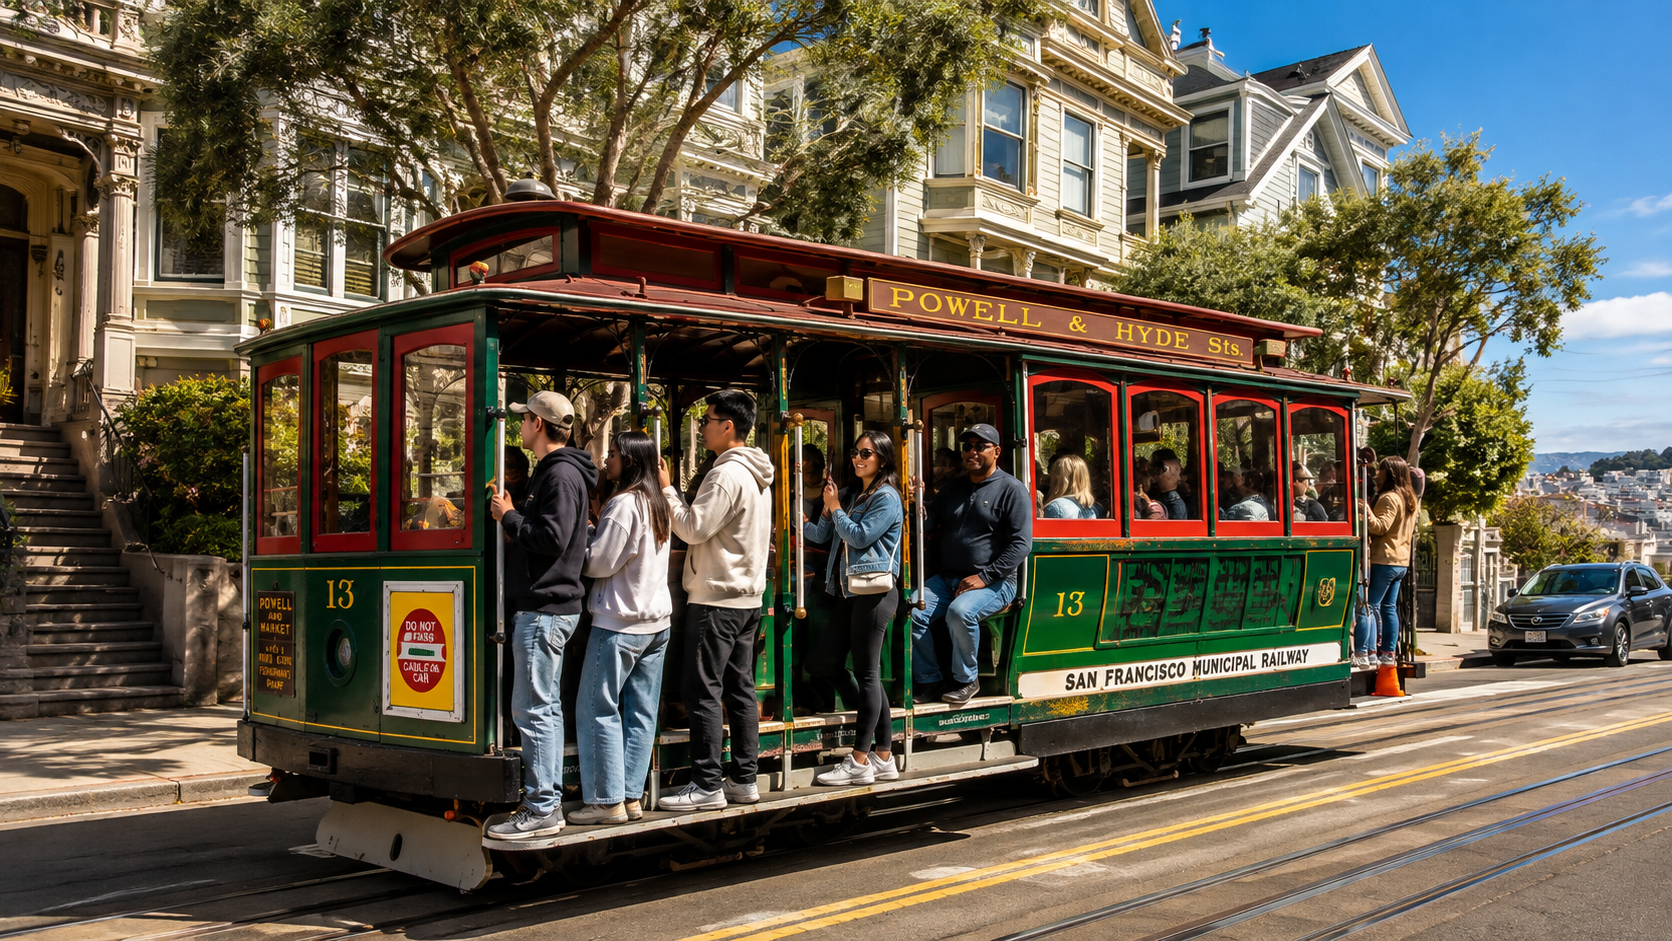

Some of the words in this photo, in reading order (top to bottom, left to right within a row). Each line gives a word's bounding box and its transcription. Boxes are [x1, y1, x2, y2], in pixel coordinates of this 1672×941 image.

[889, 286, 1042, 328] POWELL
[1068, 315, 1087, 334] &
[1115, 321, 1190, 350] HYDE
[1208, 337, 1244, 357] Sts.
[259, 597, 293, 611] POWELL
[326, 579, 355, 609] 13
[1053, 591, 1085, 617] 13
[405, 620, 417, 632] DO
[419, 621, 437, 632] NOT
[1065, 670, 1098, 691] SAN
[1104, 661, 1186, 688] FRANCISCO
[1192, 654, 1257, 677] MUNICIPAL
[1261, 648, 1309, 669] RAILWAY
